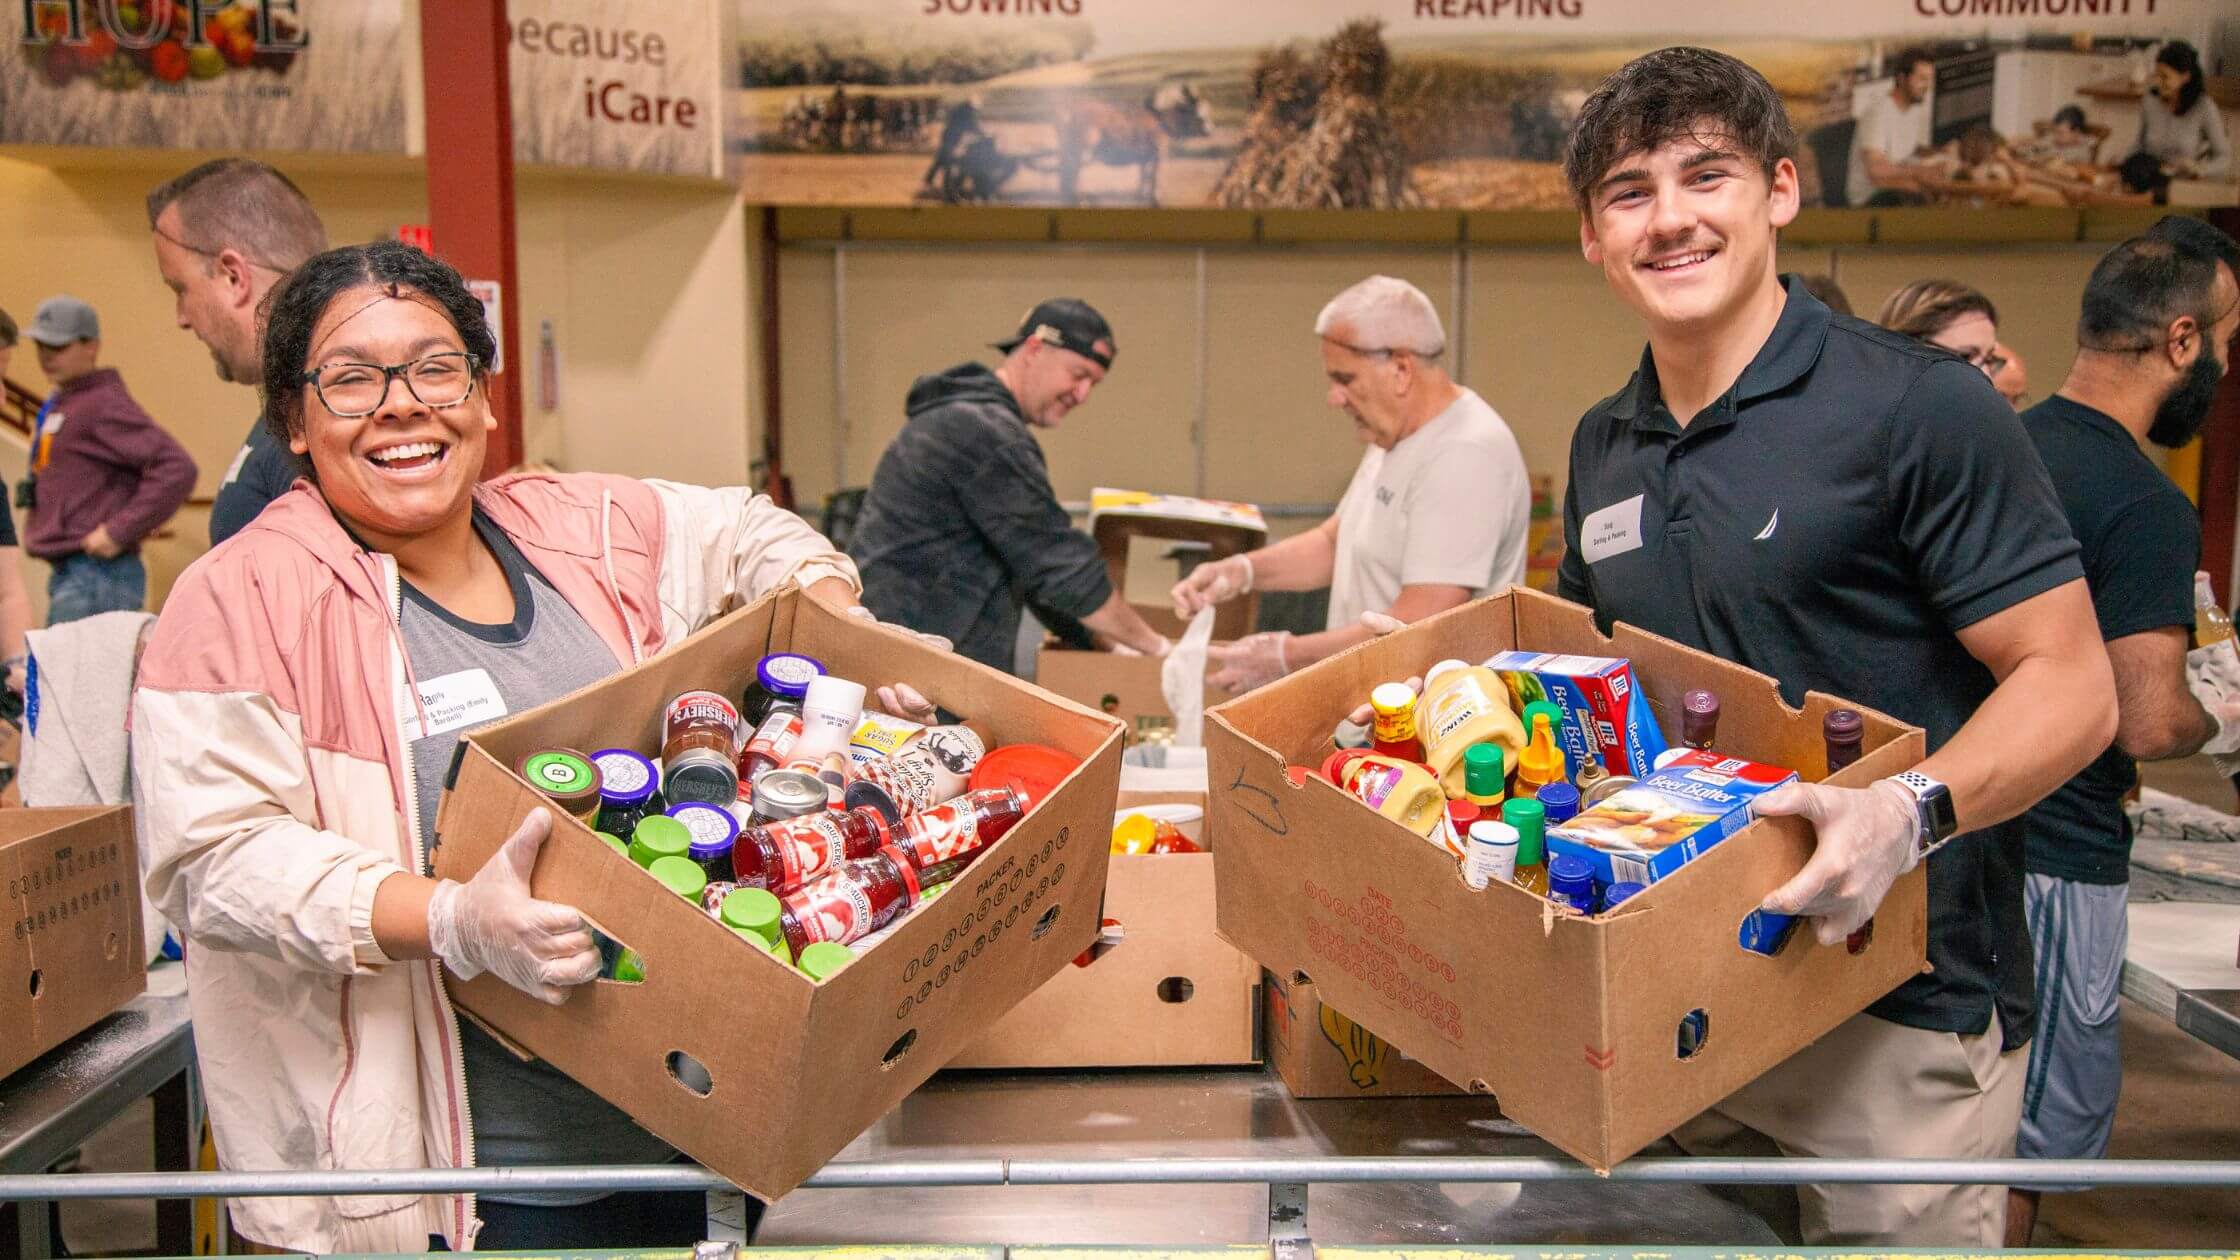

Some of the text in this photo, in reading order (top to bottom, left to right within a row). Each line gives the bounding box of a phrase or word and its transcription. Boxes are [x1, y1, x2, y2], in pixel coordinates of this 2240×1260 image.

[507, 17, 667, 66] ecause
[585, 77, 699, 128] iCare
[673, 704, 735, 731] HERSHEY'S
[1440, 710, 1473, 737] HEINZ
[1552, 685, 1585, 770] Beer Batte
[1628, 721, 1649, 779] Beer Batte
[892, 760, 929, 799] Sundae
[906, 758, 936, 787] Syrup
[1647, 774, 1688, 792] Beer
[1682, 783, 1738, 803] Batter
[818, 819, 842, 868] SMUCKER'S
[976, 855, 1015, 898] PACKER
